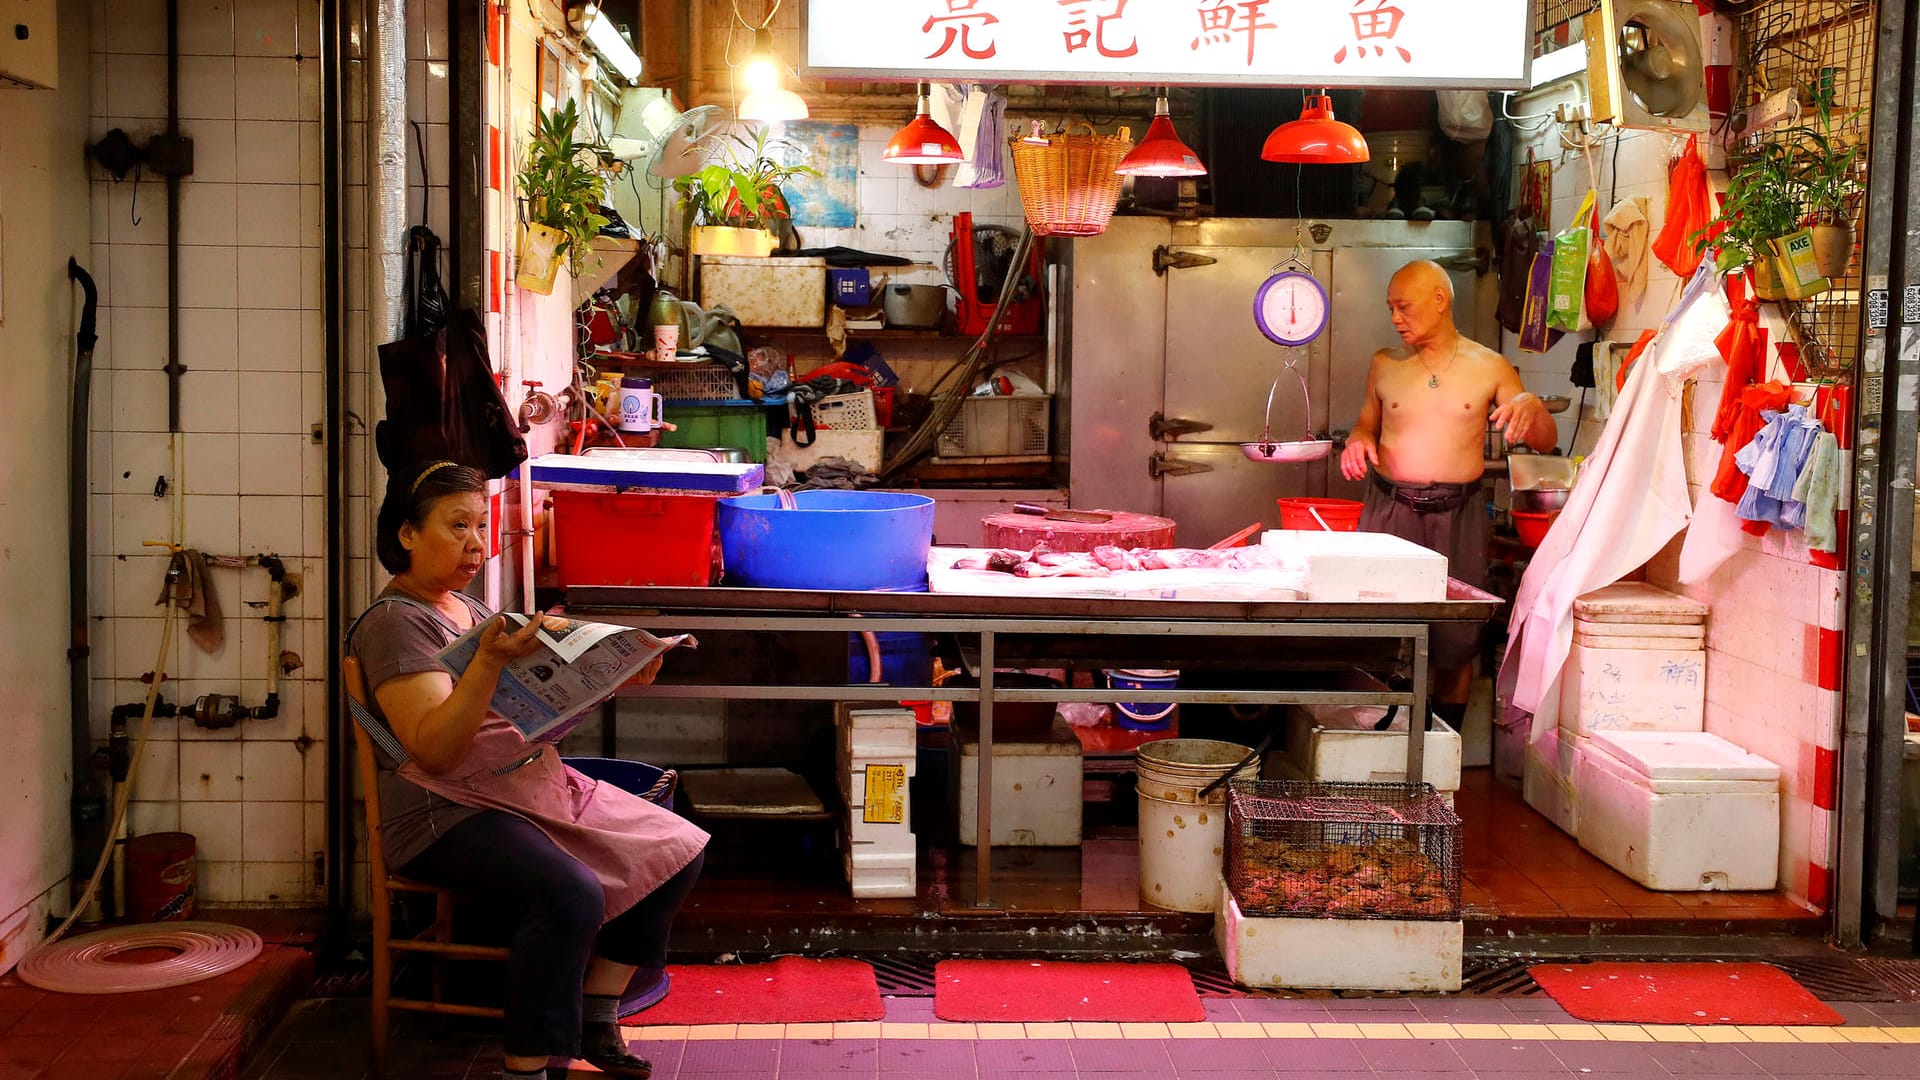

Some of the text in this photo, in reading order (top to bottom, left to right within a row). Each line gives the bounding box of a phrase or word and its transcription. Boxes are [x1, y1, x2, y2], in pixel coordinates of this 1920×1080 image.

[921, 0, 1413, 65] 亮記鮮魚
[1789, 237, 1810, 253] AXE
[1907, 288, 1916, 321] 6208 3293
